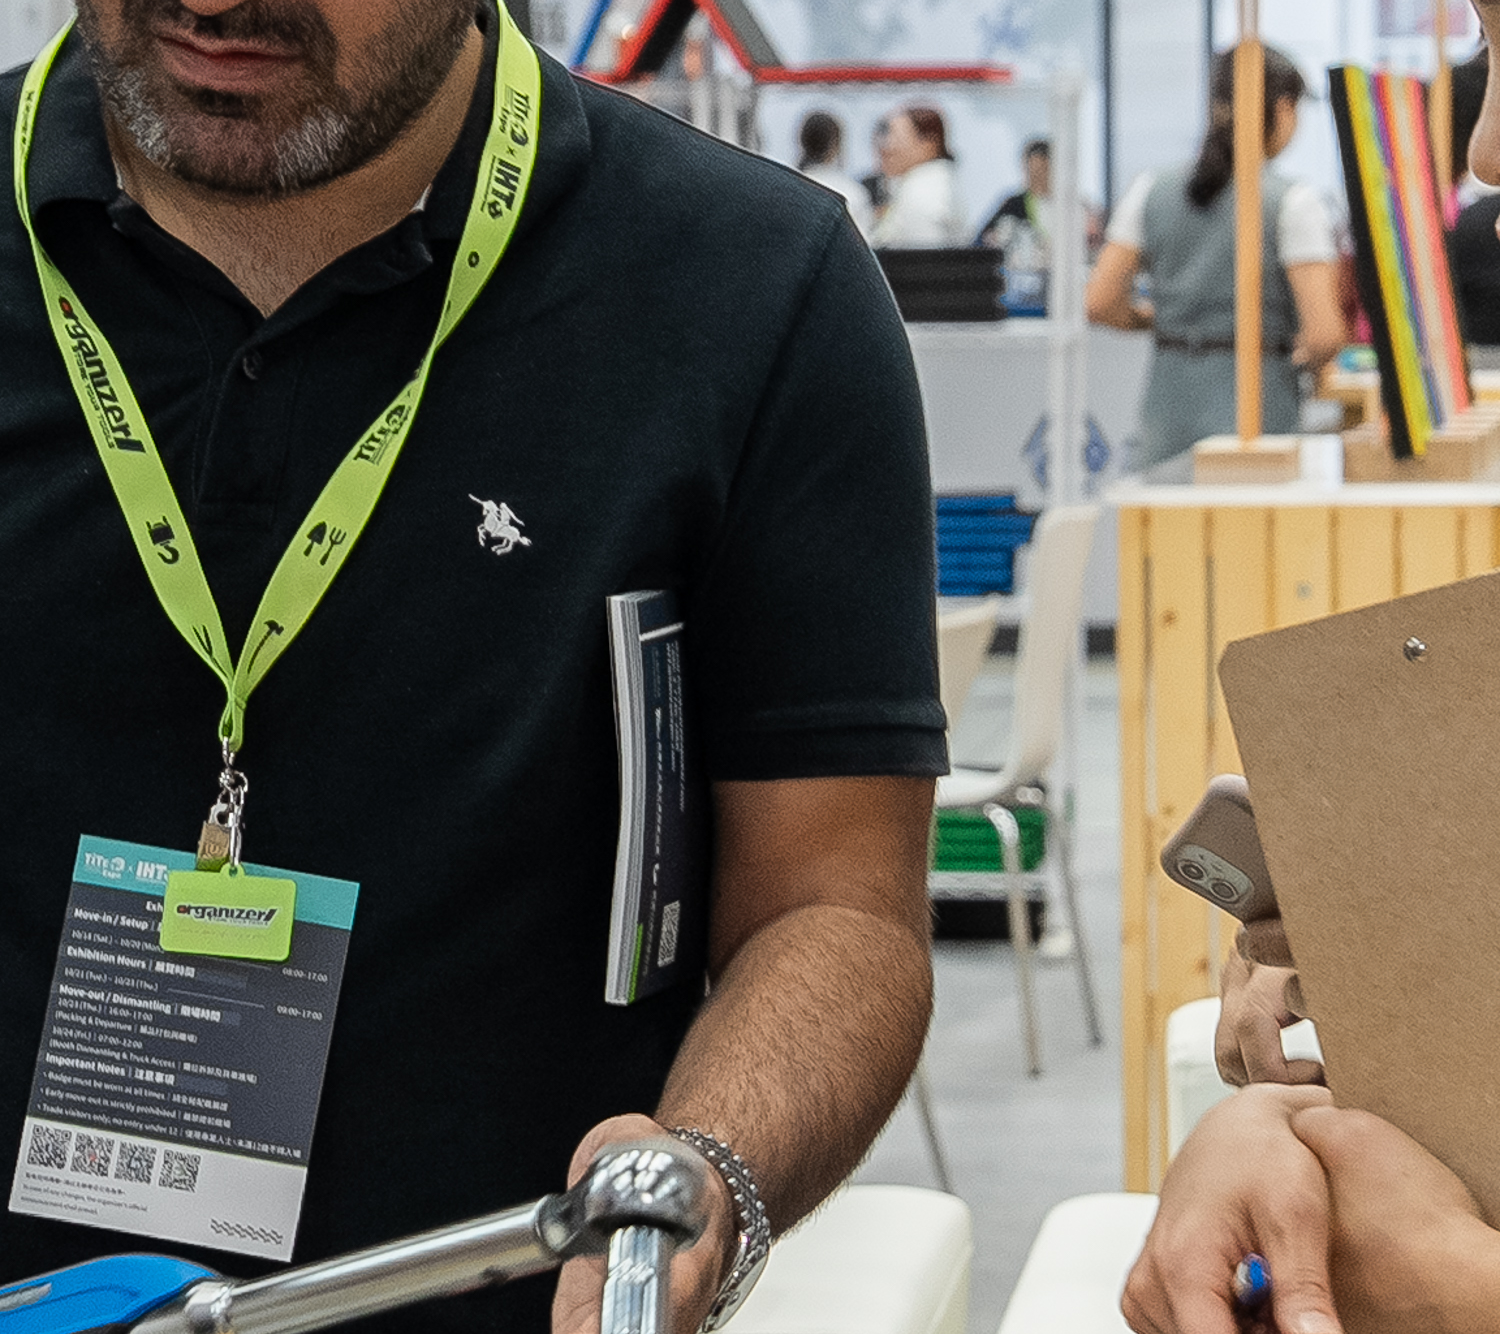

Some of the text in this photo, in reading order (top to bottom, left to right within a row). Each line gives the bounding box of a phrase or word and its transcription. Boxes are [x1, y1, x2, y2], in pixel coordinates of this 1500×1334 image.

[73, 907, 112, 924] Move-in
[119, 915, 149, 931] Setup
[145, 900, 164, 913] Exh
[66, 944, 147, 969] Exhibition Hours
[58, 983, 105, 1001] Move-out
[111, 992, 172, 1015] Dismantling
[44, 1052, 126, 1077] Important Notes
